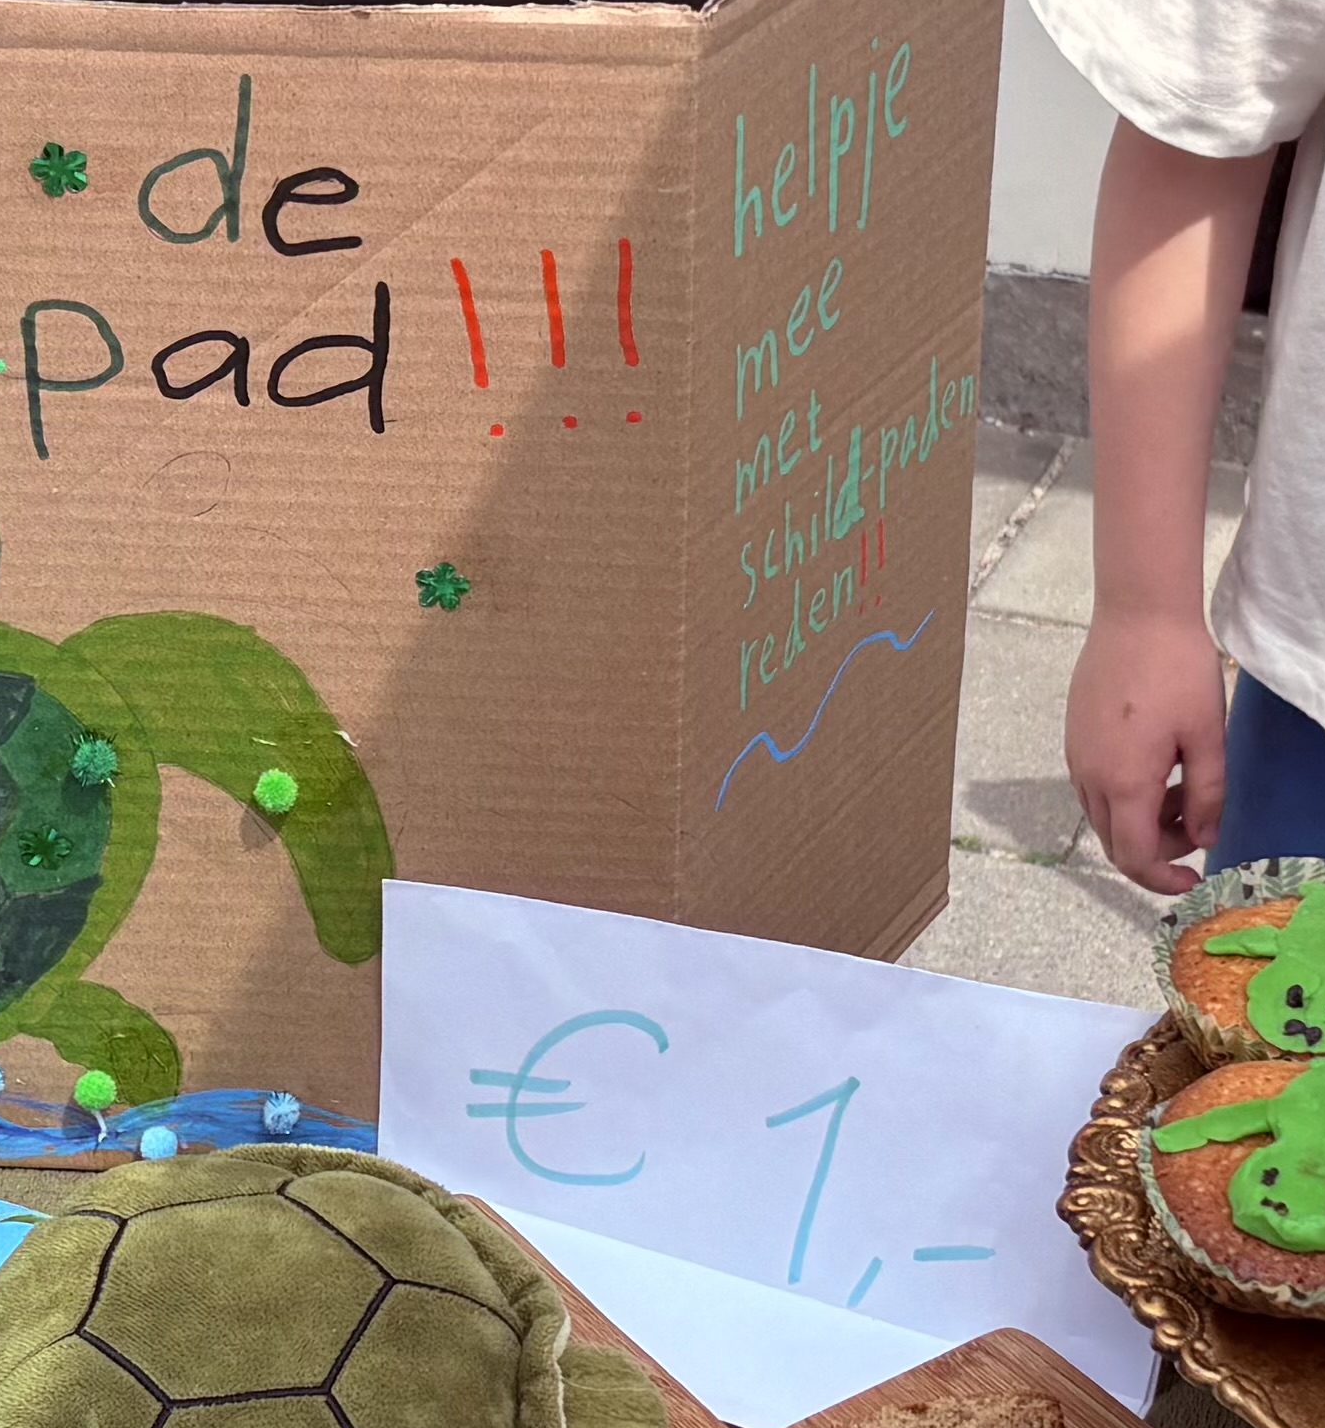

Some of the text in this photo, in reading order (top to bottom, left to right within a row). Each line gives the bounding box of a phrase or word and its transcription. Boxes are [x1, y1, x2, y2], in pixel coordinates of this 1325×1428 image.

[136, 73, 363, 258] de
[737, 258, 843, 421] mee
[734, 389, 822, 518] met
[465, 1008, 670, 1186] €
